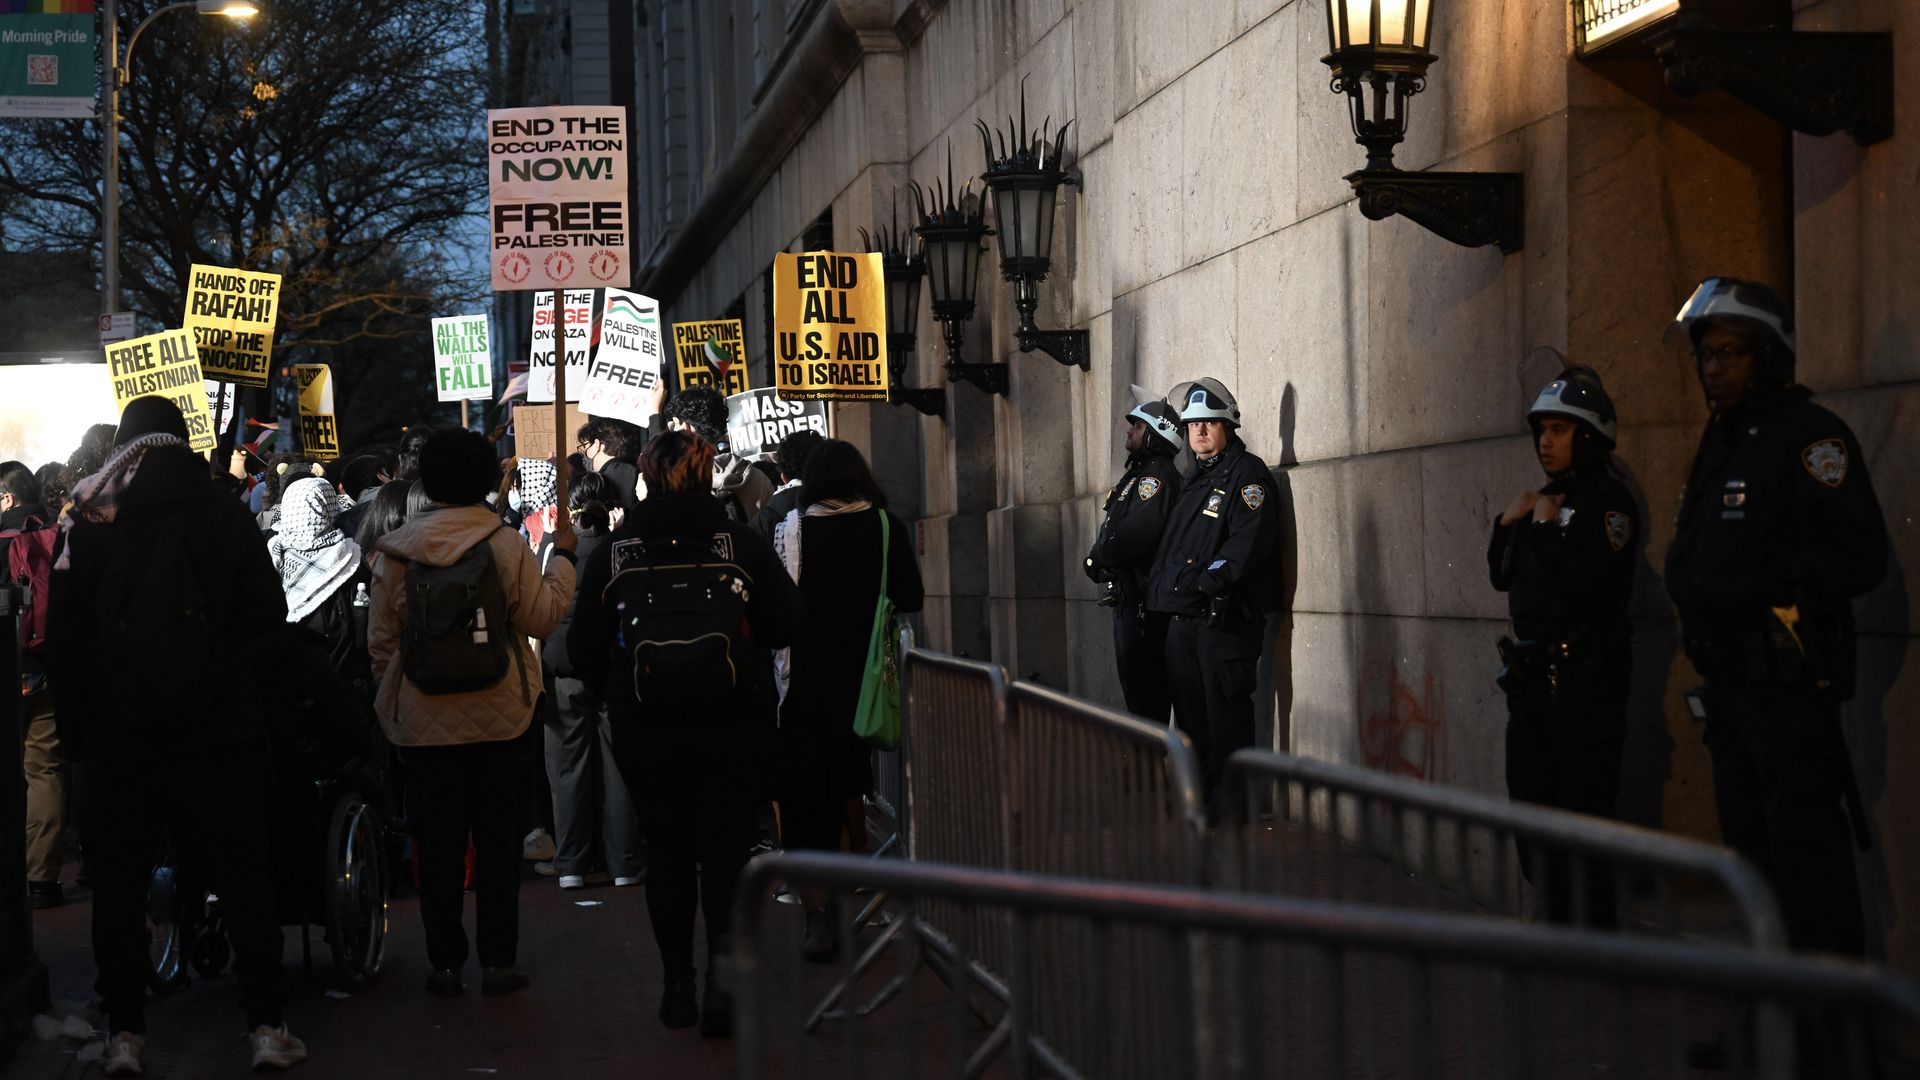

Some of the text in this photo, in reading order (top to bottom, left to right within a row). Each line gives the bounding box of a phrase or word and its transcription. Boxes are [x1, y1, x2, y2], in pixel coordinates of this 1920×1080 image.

[2, 30, 87, 46] Morning Pride
[492, 117, 620, 137] END THE
[491, 140, 622, 154] OCCUPATION
[501, 157, 613, 182] NOW!
[494, 202, 623, 233] FREE
[495, 233, 624, 249] PALESTINE!
[195, 272, 276, 296] HANDS OFF
[797, 255, 857, 289] END
[191, 291, 271, 323] RAFAH!
[536, 293, 591, 306] LIF THE
[803, 290, 856, 324] ALL
[193, 326, 264, 352] STOP THE
[437, 320, 487, 338] ALL THE
[534, 330, 550, 340] ON
[604, 319, 657, 341] PALESTINE
[676, 322, 741, 344] PALESTINE
[110, 335, 195, 377] FREE ALL
[437, 335, 488, 355] WALLS
[604, 332, 657, 357] WILL BE
[780, 331, 879, 361] U.S. AID
[452, 354, 475, 366] WILL
[115, 364, 200, 399] PALESTINIAN
[440, 364, 490, 391] FALL
[593, 361, 658, 390] FREE!
[779, 363, 881, 386] TO ISRAEL!
[740, 395, 804, 423] MASS
[302, 415, 337, 450] FREE!
[730, 414, 825, 452] MURDER
